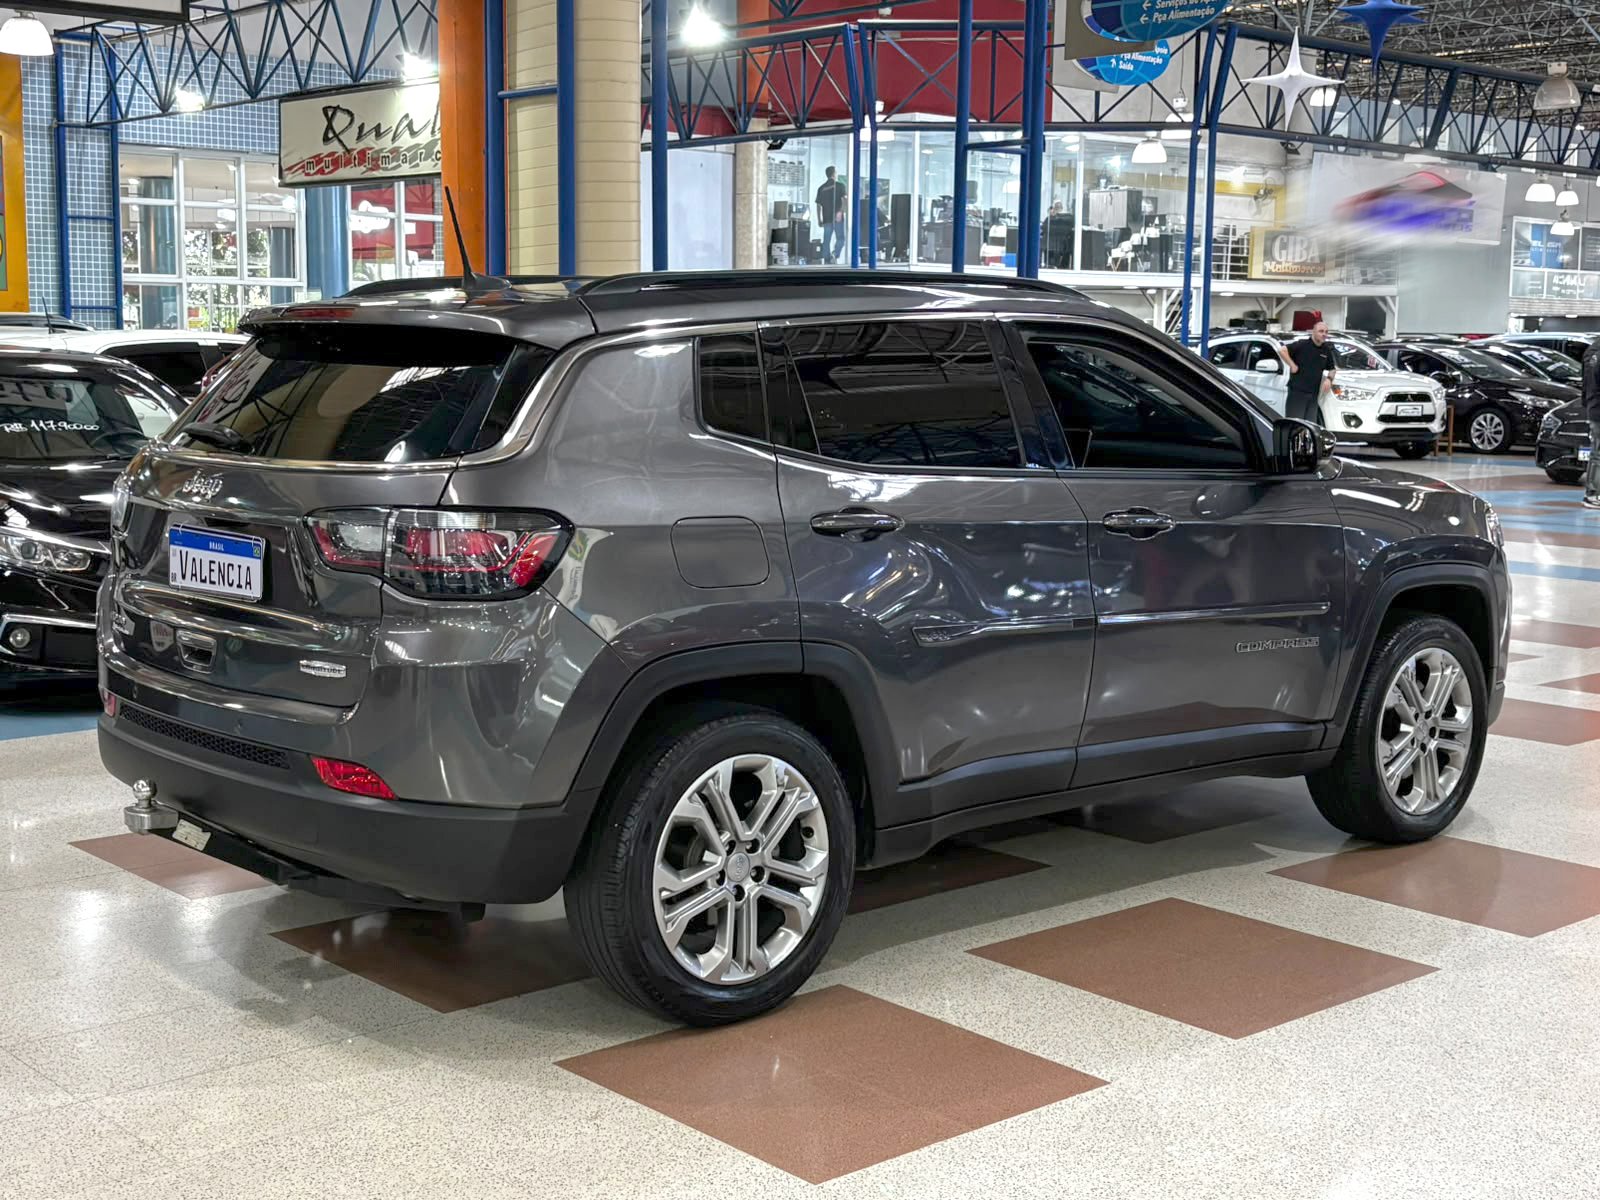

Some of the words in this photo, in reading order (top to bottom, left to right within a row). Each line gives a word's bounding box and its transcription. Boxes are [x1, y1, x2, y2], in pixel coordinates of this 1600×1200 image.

[1168, 5, 1215, 20] Alimentação
[1154, 44, 1169, 55] poio
[1271, 234, 1320, 263] GIBA
[182, 470, 223, 500] Jeep
[209, 540, 225, 552] BRASIL
[179, 549, 252, 591] VALENCIA
